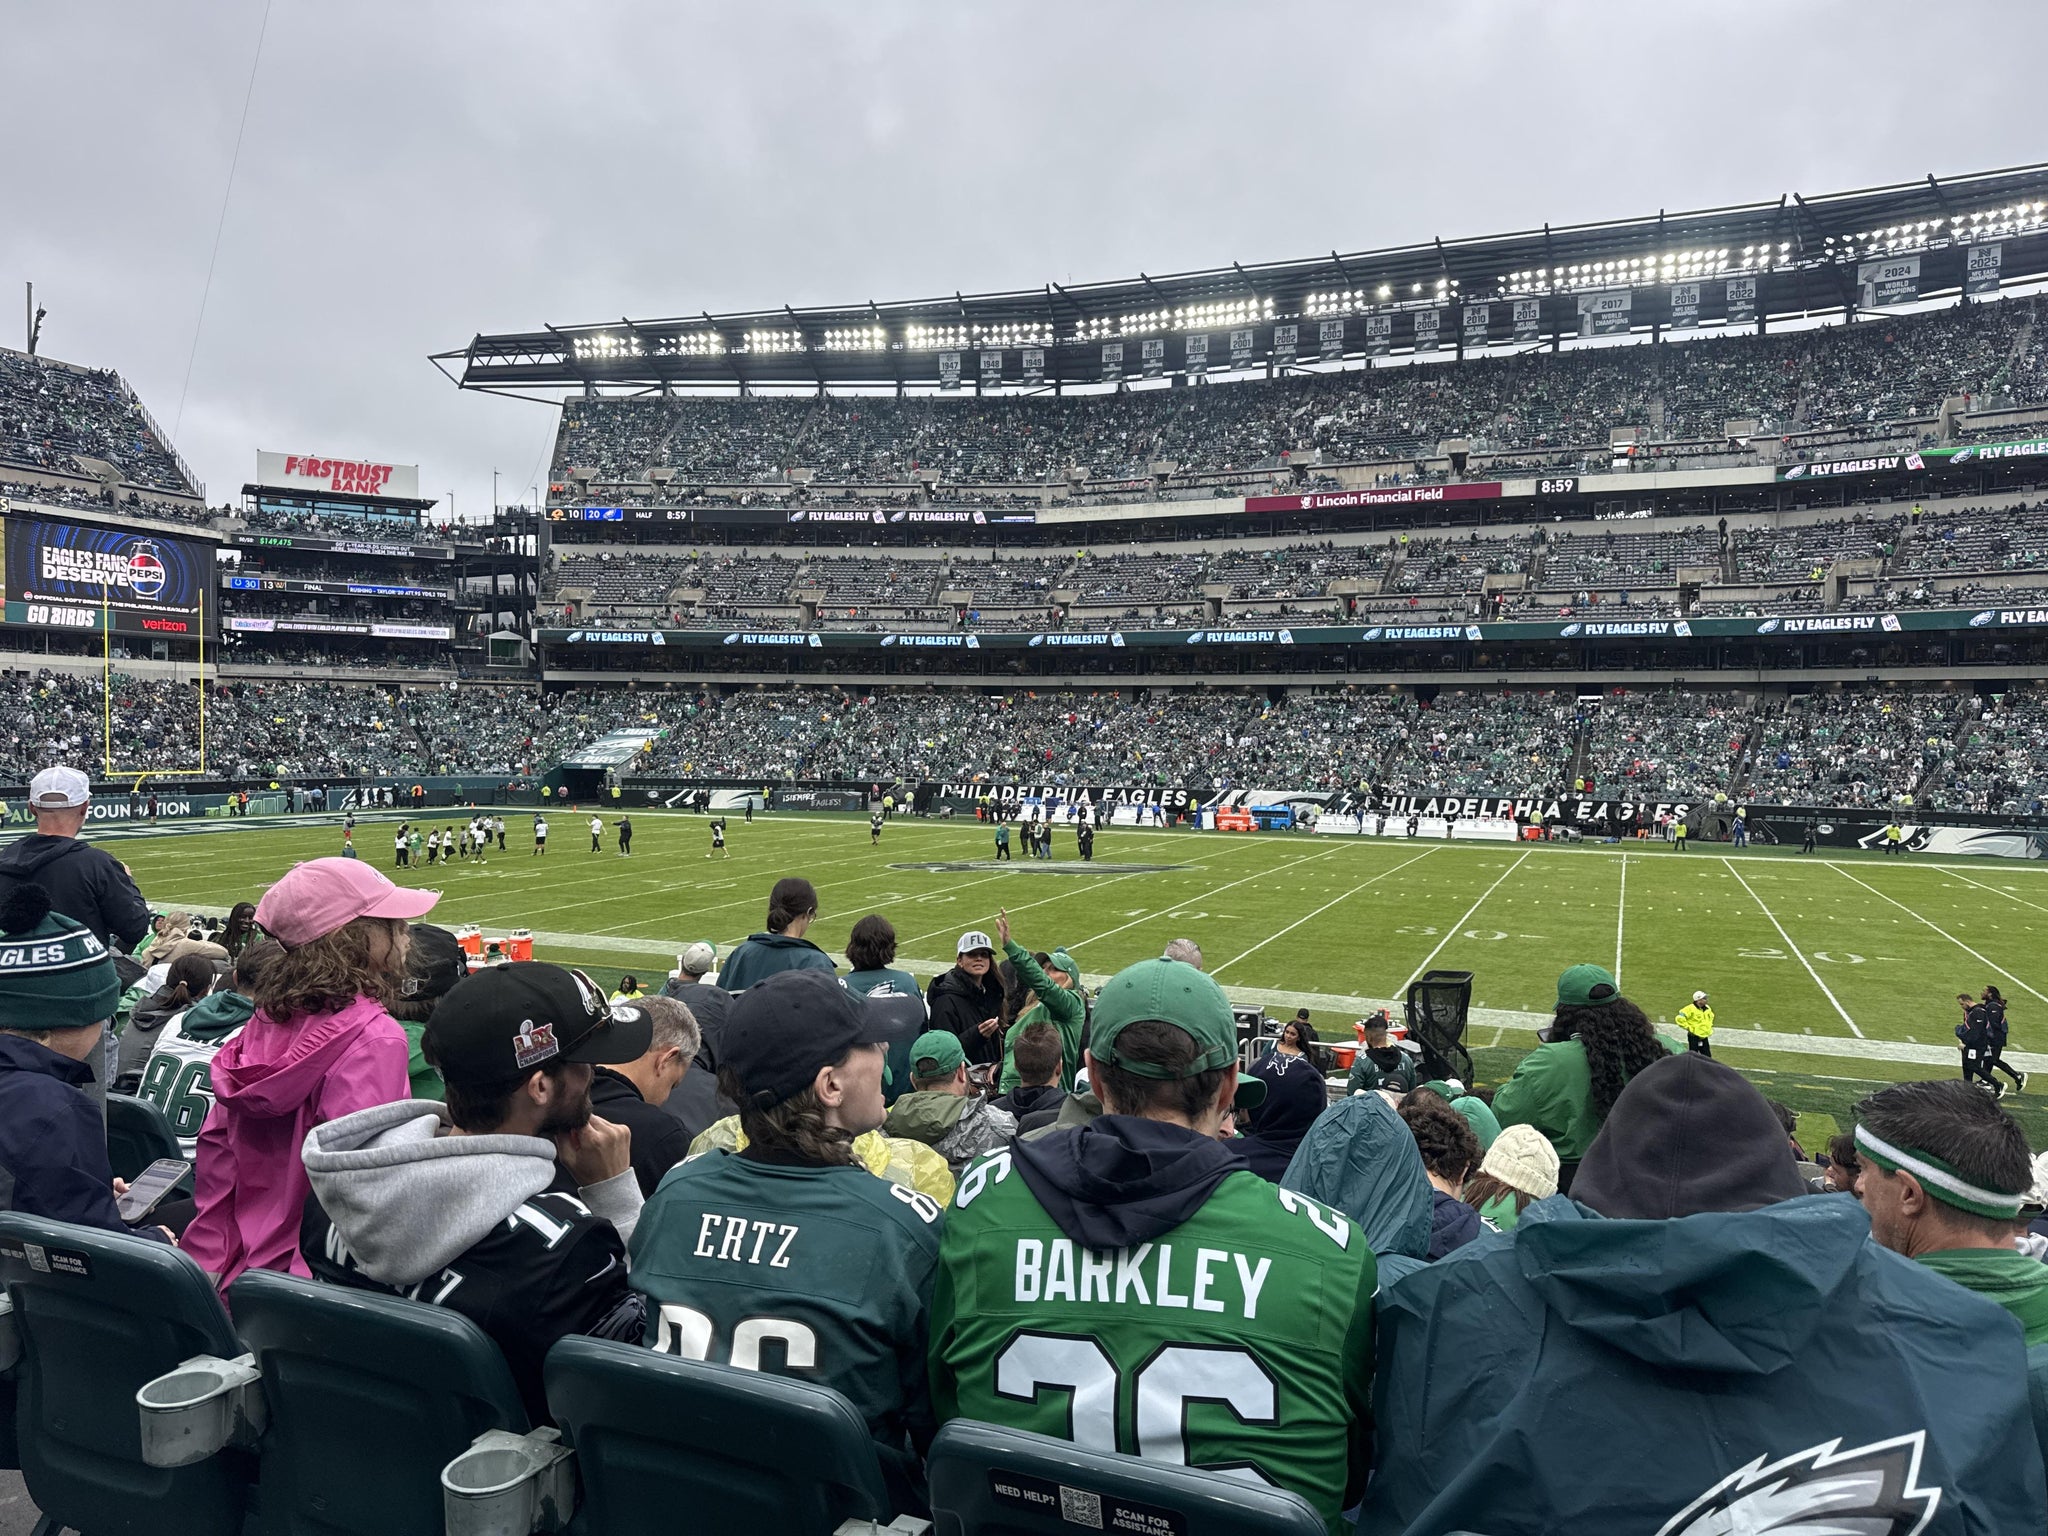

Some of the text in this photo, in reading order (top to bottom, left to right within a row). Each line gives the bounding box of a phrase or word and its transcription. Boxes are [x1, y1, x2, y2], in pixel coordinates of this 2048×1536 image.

[1970, 257, 1998, 268] 2025
[1885, 266, 1911, 277] 2024
[1885, 281, 1909, 290] WORLD
[1729, 289, 1753, 298] 2022
[1877, 286, 1916, 297] CHAMPIONS
[1601, 299, 1623, 309] 2017
[1675, 295, 1697, 304] 2019
[1517, 309, 1536, 318] 2013
[1601, 312, 1622, 320] WORLD
[1467, 315, 1486, 324] 2010
[1595, 317, 1628, 326] CHAMPIONS
[1322, 330, 1342, 339] 2003
[1368, 325, 1389, 335] 2004
[1233, 339, 1251, 348] 2001
[1276, 335, 1296, 344] 2002
[942, 362, 958, 370] 1947
[1025, 359, 1042, 367] 1949
[1980, 447, 2002, 460] FLY
[1811, 456, 1899, 476] FLY EAGLES FLY
[331, 479, 381, 494] BANK
[1541, 480, 1573, 493] 8:59
[1317, 488, 1443, 507] Lincoln Financial Field
[569, 510, 579, 519] 10
[589, 510, 600, 519] 20
[636, 511, 652, 519] HALF
[667, 511, 686, 520] 8:59
[809, 512, 869, 521] FLY EAGLES FLY
[909, 512, 970, 521] FLY EAGLES FLY
[260, 538, 292, 546] $149,475
[43, 547, 128, 573] EAGLES FANS
[43, 564, 129, 587] DESERVE
[129, 568, 163, 580] PEPSI
[245, 580, 256, 588] 30
[263, 581, 274, 589] 13
[304, 583, 323, 591] FINAL
[34, 594, 63, 603] OFFICIAL
[83, 598, 102, 606] DRINK
[124, 602, 166, 611] PHILADELPHIA
[27, 605, 95, 627] GO BIRDS
[2001, 612, 2025, 623] FLY
[142, 619, 187, 632] verizon
[1586, 623, 1669, 634] FLY EAGLES FLY
[1784, 617, 1875, 630] FLY EAGLES FLY
[586, 632, 648, 642] FLY EAGLES FLY
[1207, 632, 1274, 642] FLY EAGLES FLY
[1386, 627, 1461, 638] FLY EAGLES FLY
[743, 634, 805, 644] FLY EAGLES FLY
[900, 636, 962, 645] FLY EAGLES FLY
[1047, 634, 1108, 644] FLY EAGLES FLY
[940, 784, 1188, 807] PHILADELPHIA EAGLES
[971, 935, 988, 946] FLY
[0, 944, 65, 966] GLES
[519, 1047, 557, 1067] CHAMPIONS
[139, 1051, 215, 1137] 86
[693, 1213, 799, 1269] ERTZ
[52, 1255, 83, 1266] SCAN FOR
[52, 1262, 88, 1275] ASSISTANCE
[1015, 1238, 1272, 1319] BARKLEY
[994, 1483, 1055, 1505] NEED HELP?
[1115, 1508, 1170, 1529] SCAN FOR
[1112, 1517, 1175, 1536] ASSISTANCE
